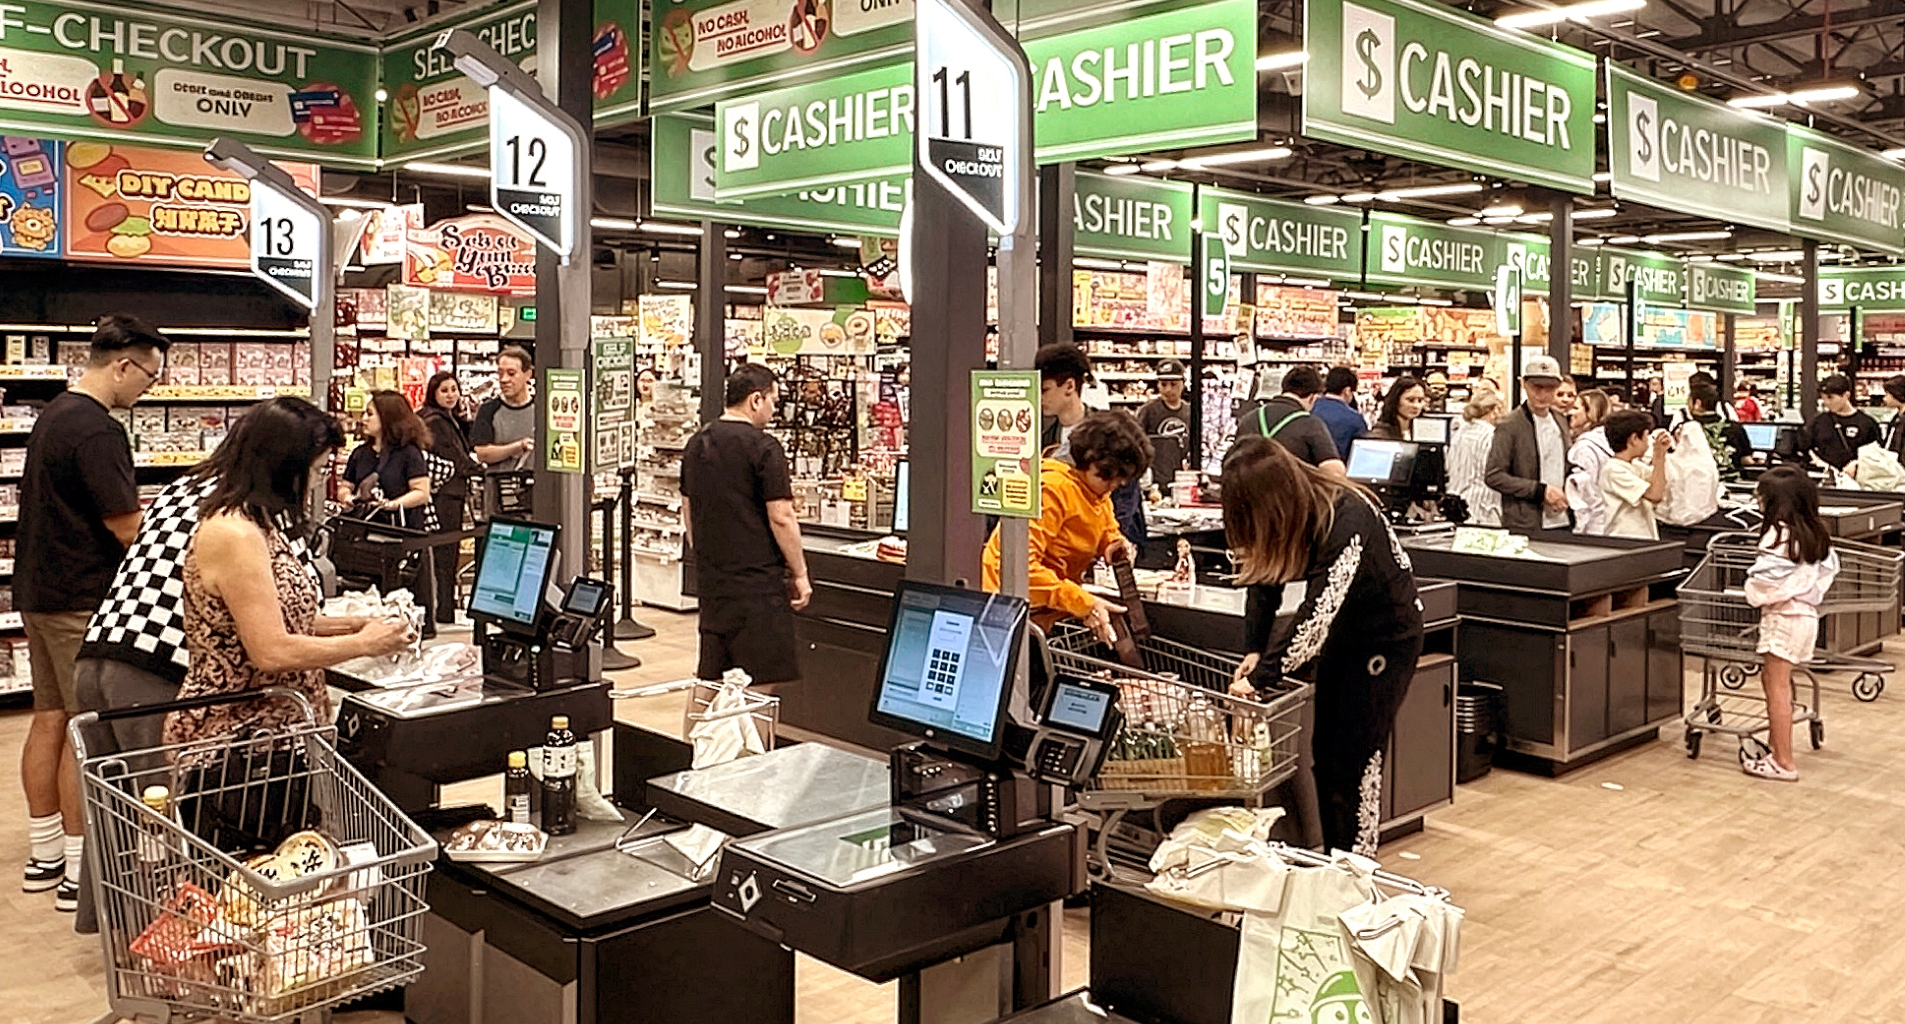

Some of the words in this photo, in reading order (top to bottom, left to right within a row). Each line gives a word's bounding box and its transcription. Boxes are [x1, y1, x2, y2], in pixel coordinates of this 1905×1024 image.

[1032, 28, 1235, 113] ASHIER
[761, 84, 915, 155] CASHIER
[932, 66, 972, 139] 11
[1400, 42, 1571, 150] CASHIER
[506, 135, 547, 188] 12
[1660, 119, 1771, 195] CASHIER
[120, 173, 173, 198] DIY
[1829, 167, 1900, 230] CASHIER
[260, 217, 294, 256] 13
[1249, 216, 1348, 260] CASHIER
[1406, 236, 1484, 274] CASHIER
[1209, 259, 1227, 296] 5
[1706, 276, 1750, 303] CASHIER
[1845, 281, 1905, 301] CASH
